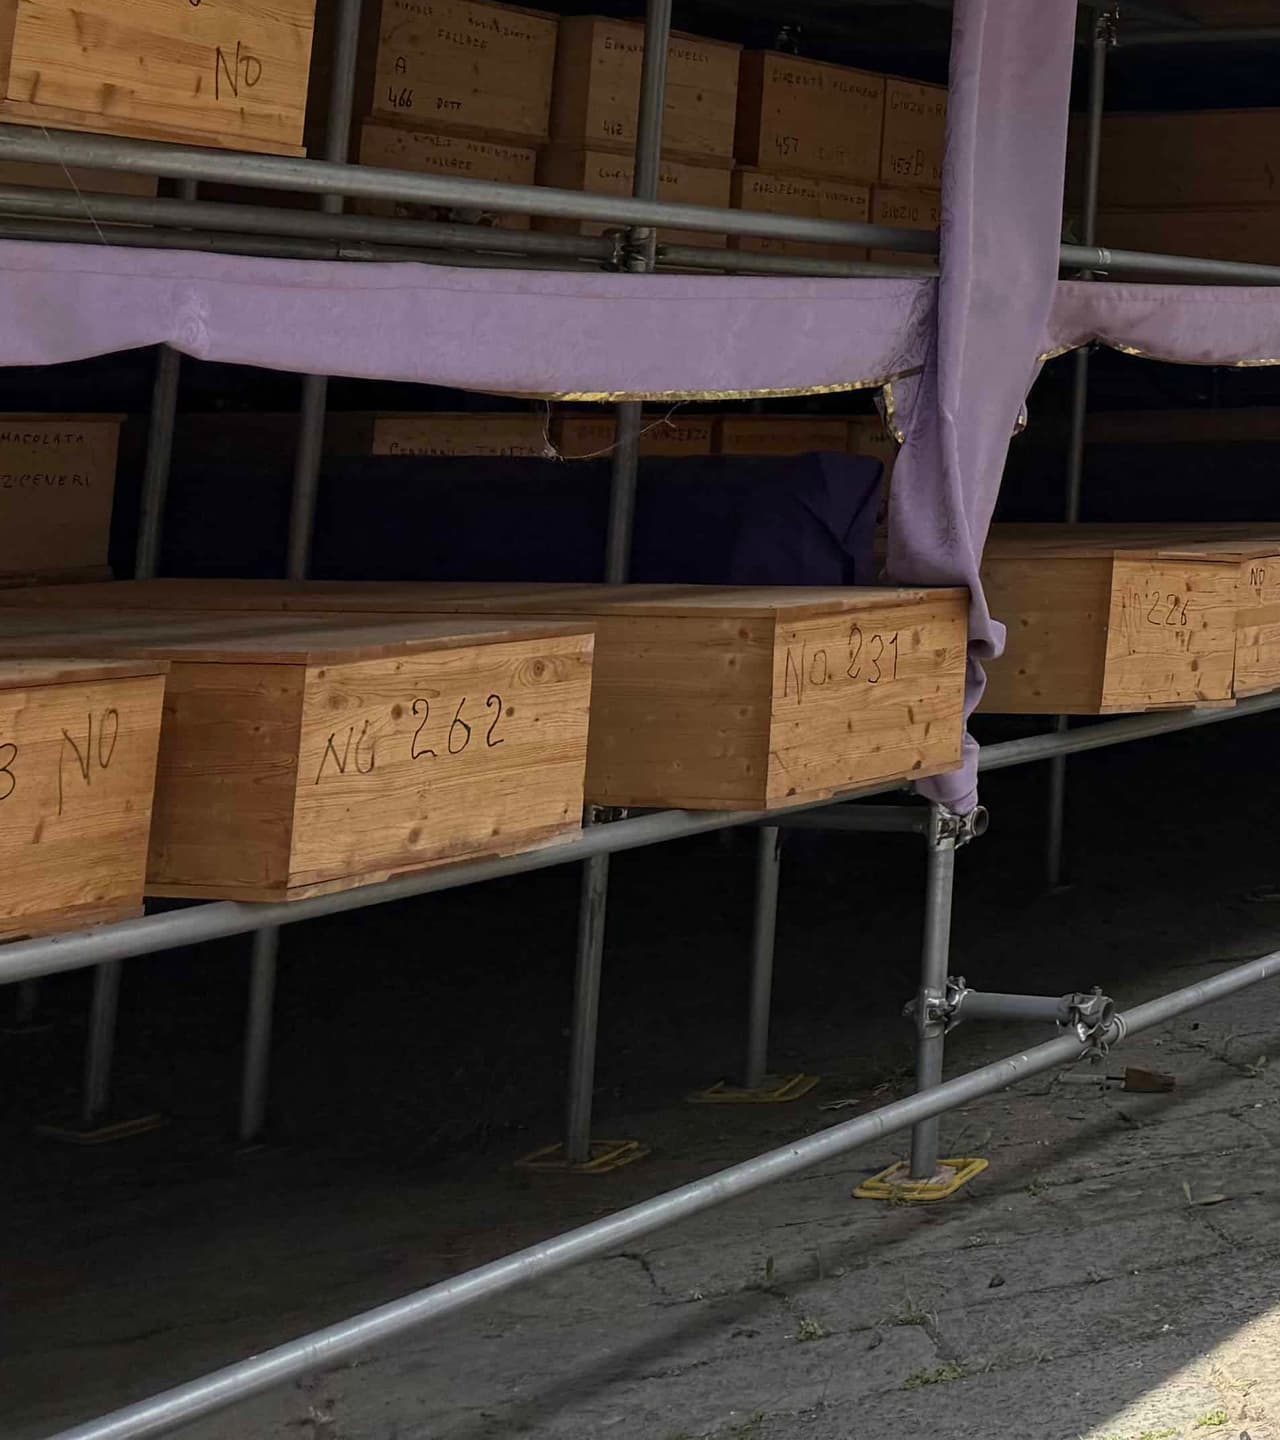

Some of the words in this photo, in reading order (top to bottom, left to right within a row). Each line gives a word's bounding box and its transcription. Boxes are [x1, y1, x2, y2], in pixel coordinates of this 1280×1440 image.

[214, 40, 263, 101] NO
[387, 87, 415, 109] 466
[1146, 590, 1190, 626] 226
[846, 623, 899, 684] 231
[410, 693, 505, 760] 262
[58, 707, 119, 817] NO
